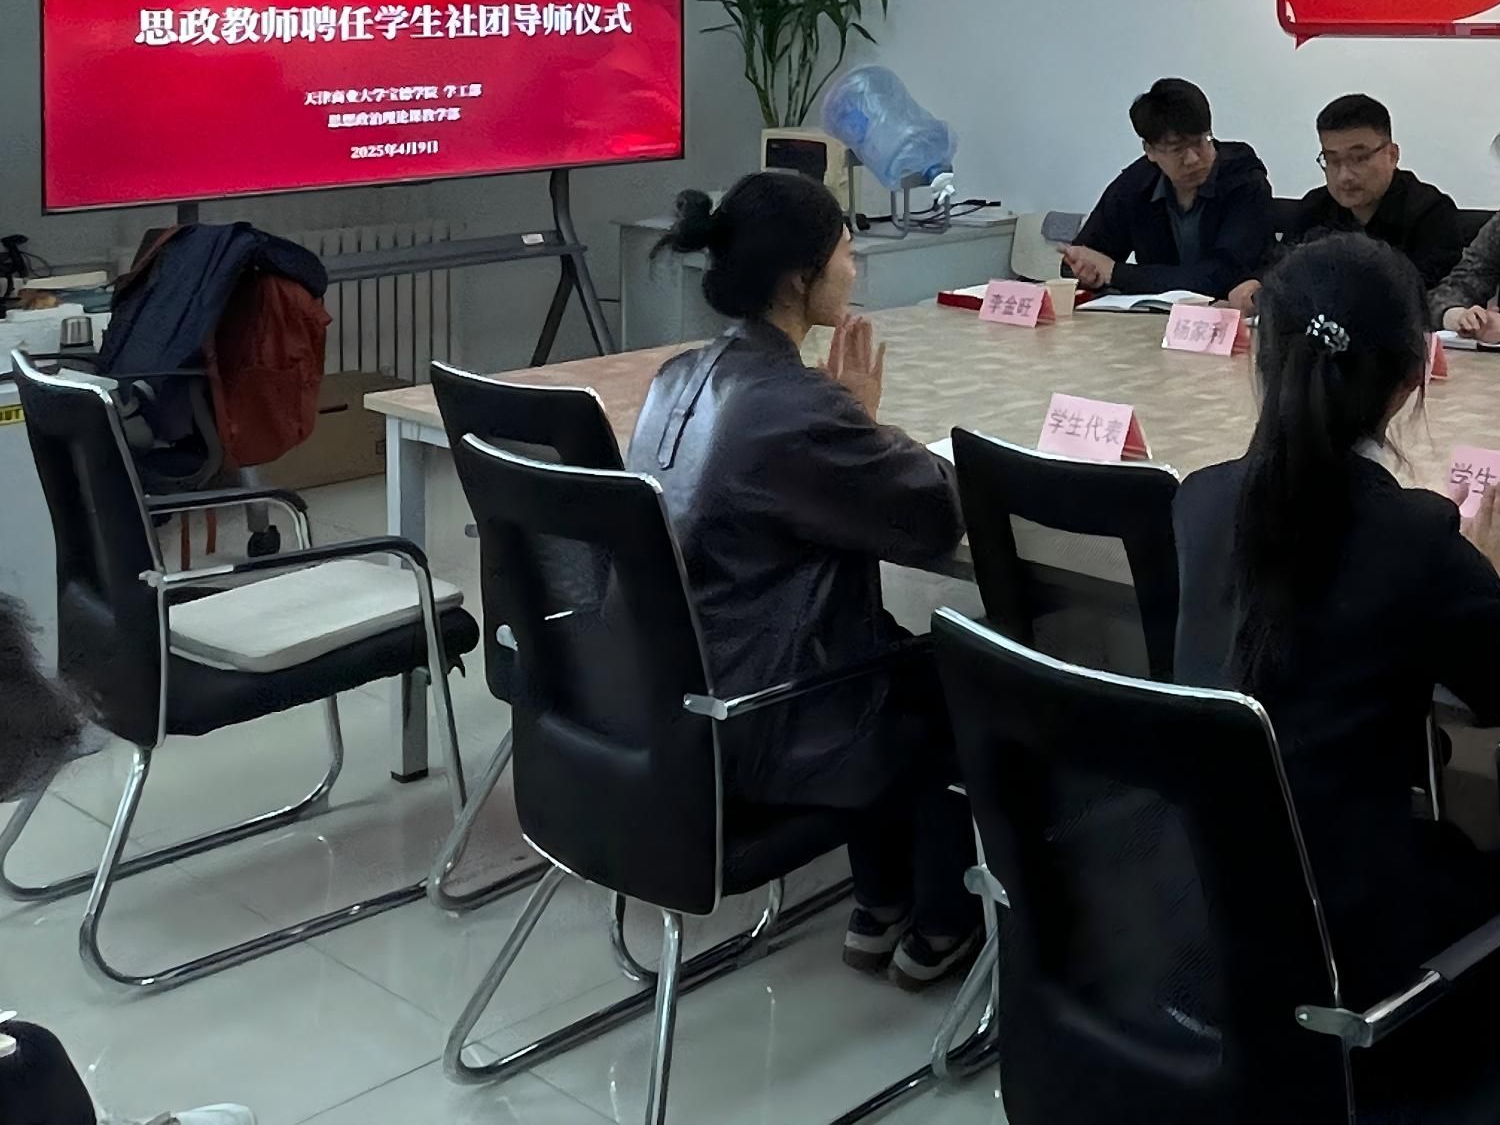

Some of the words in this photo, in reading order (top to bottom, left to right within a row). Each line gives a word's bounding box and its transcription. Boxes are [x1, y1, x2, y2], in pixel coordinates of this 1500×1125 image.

[134, 1, 633, 46] 思政教师聘任学生社团导师仪式
[351, 140, 438, 159] 2025年4月9日
[1047, 408, 1123, 445] 学生代表
